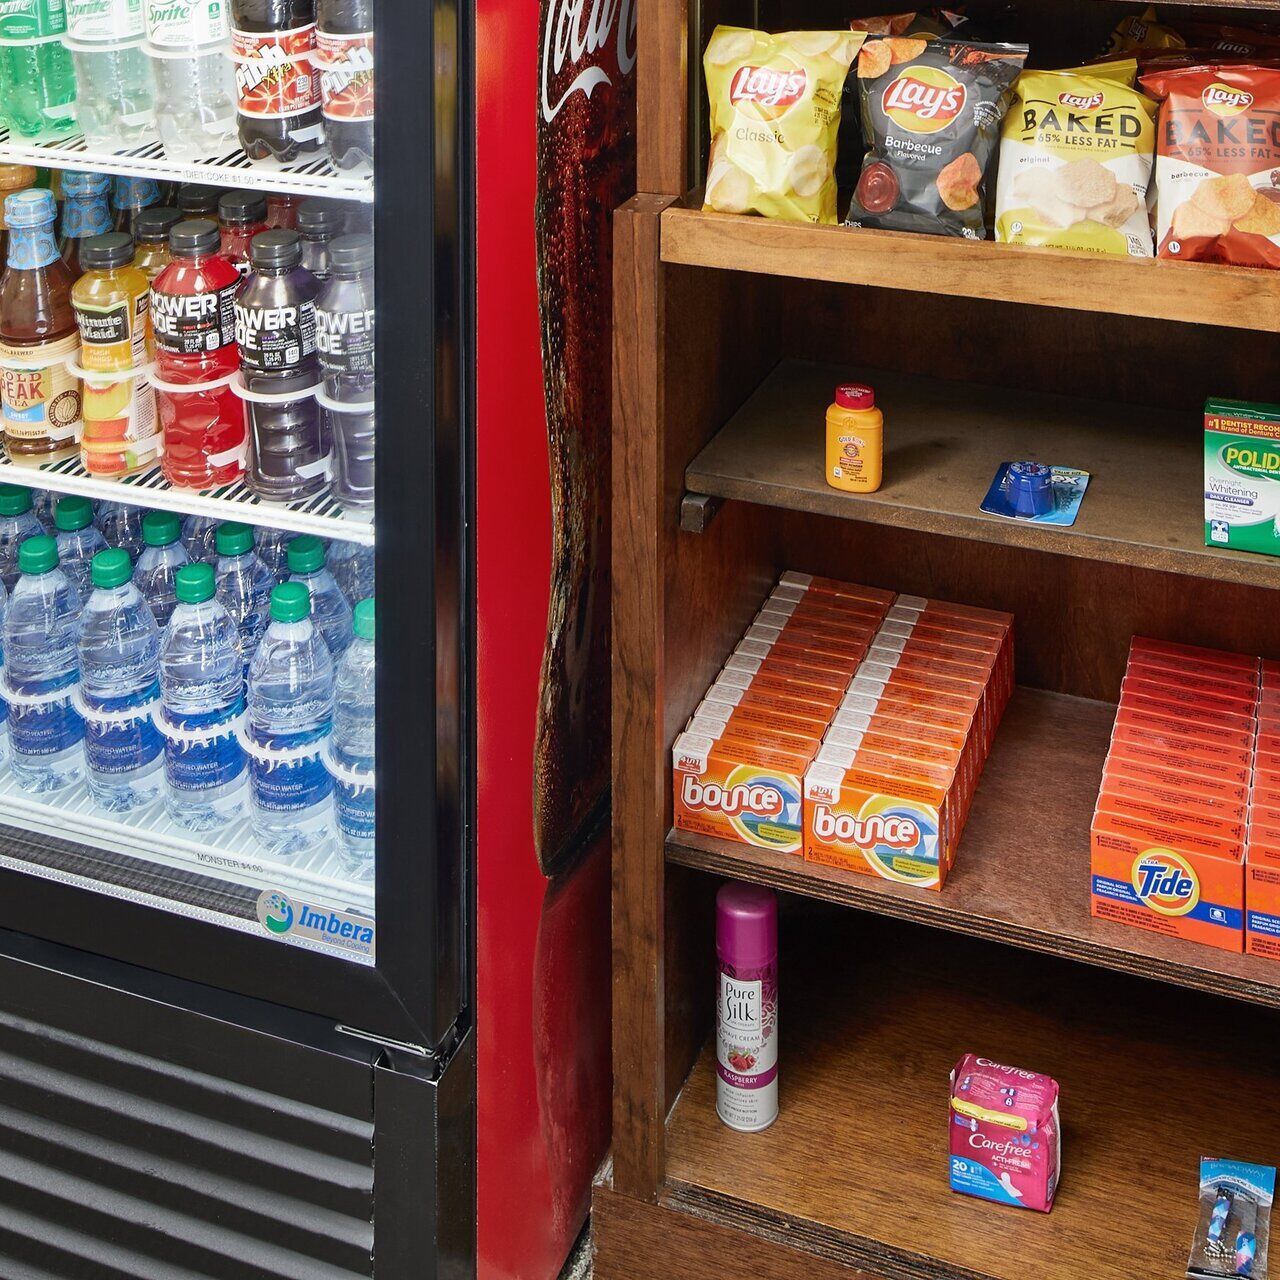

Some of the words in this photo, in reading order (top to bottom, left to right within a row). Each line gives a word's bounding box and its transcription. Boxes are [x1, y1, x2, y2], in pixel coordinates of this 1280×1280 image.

[148, 4, 190, 22] Sprite
[734, 66, 805, 106] Lay's
[886, 78, 962, 118] Lay's
[1061, 93, 1102, 110] Lay's
[1207, 88, 1252, 106] Lay's
[1021, 108, 1142, 138] BAKED
[736, 128, 784, 144] Classic
[885, 136, 942, 155] Barbecue
[1038, 133, 1060, 144] 65%
[1066, 135, 1092, 146] LESS
[1098, 137, 1118, 148] FAT
[1221, 420, 1252, 429] DENTIST
[1209, 483, 1258, 499] Whitening
[683, 774, 780, 811] bounce
[815, 805, 917, 843] bounce
[197, 853, 240, 869] MONSTER
[241, 860, 263, 872] $4.00
[1138, 865, 1193, 897] Tide
[299, 906, 373, 944] Imbera
[726, 982, 755, 1000] Pure
[727, 996, 754, 1021] Silk
[724, 1072, 758, 1084] RASPBERRY
[976, 1058, 1036, 1080] Carefree
[969, 1133, 1031, 1158] Carefree
[953, 1159, 967, 1170] 20
